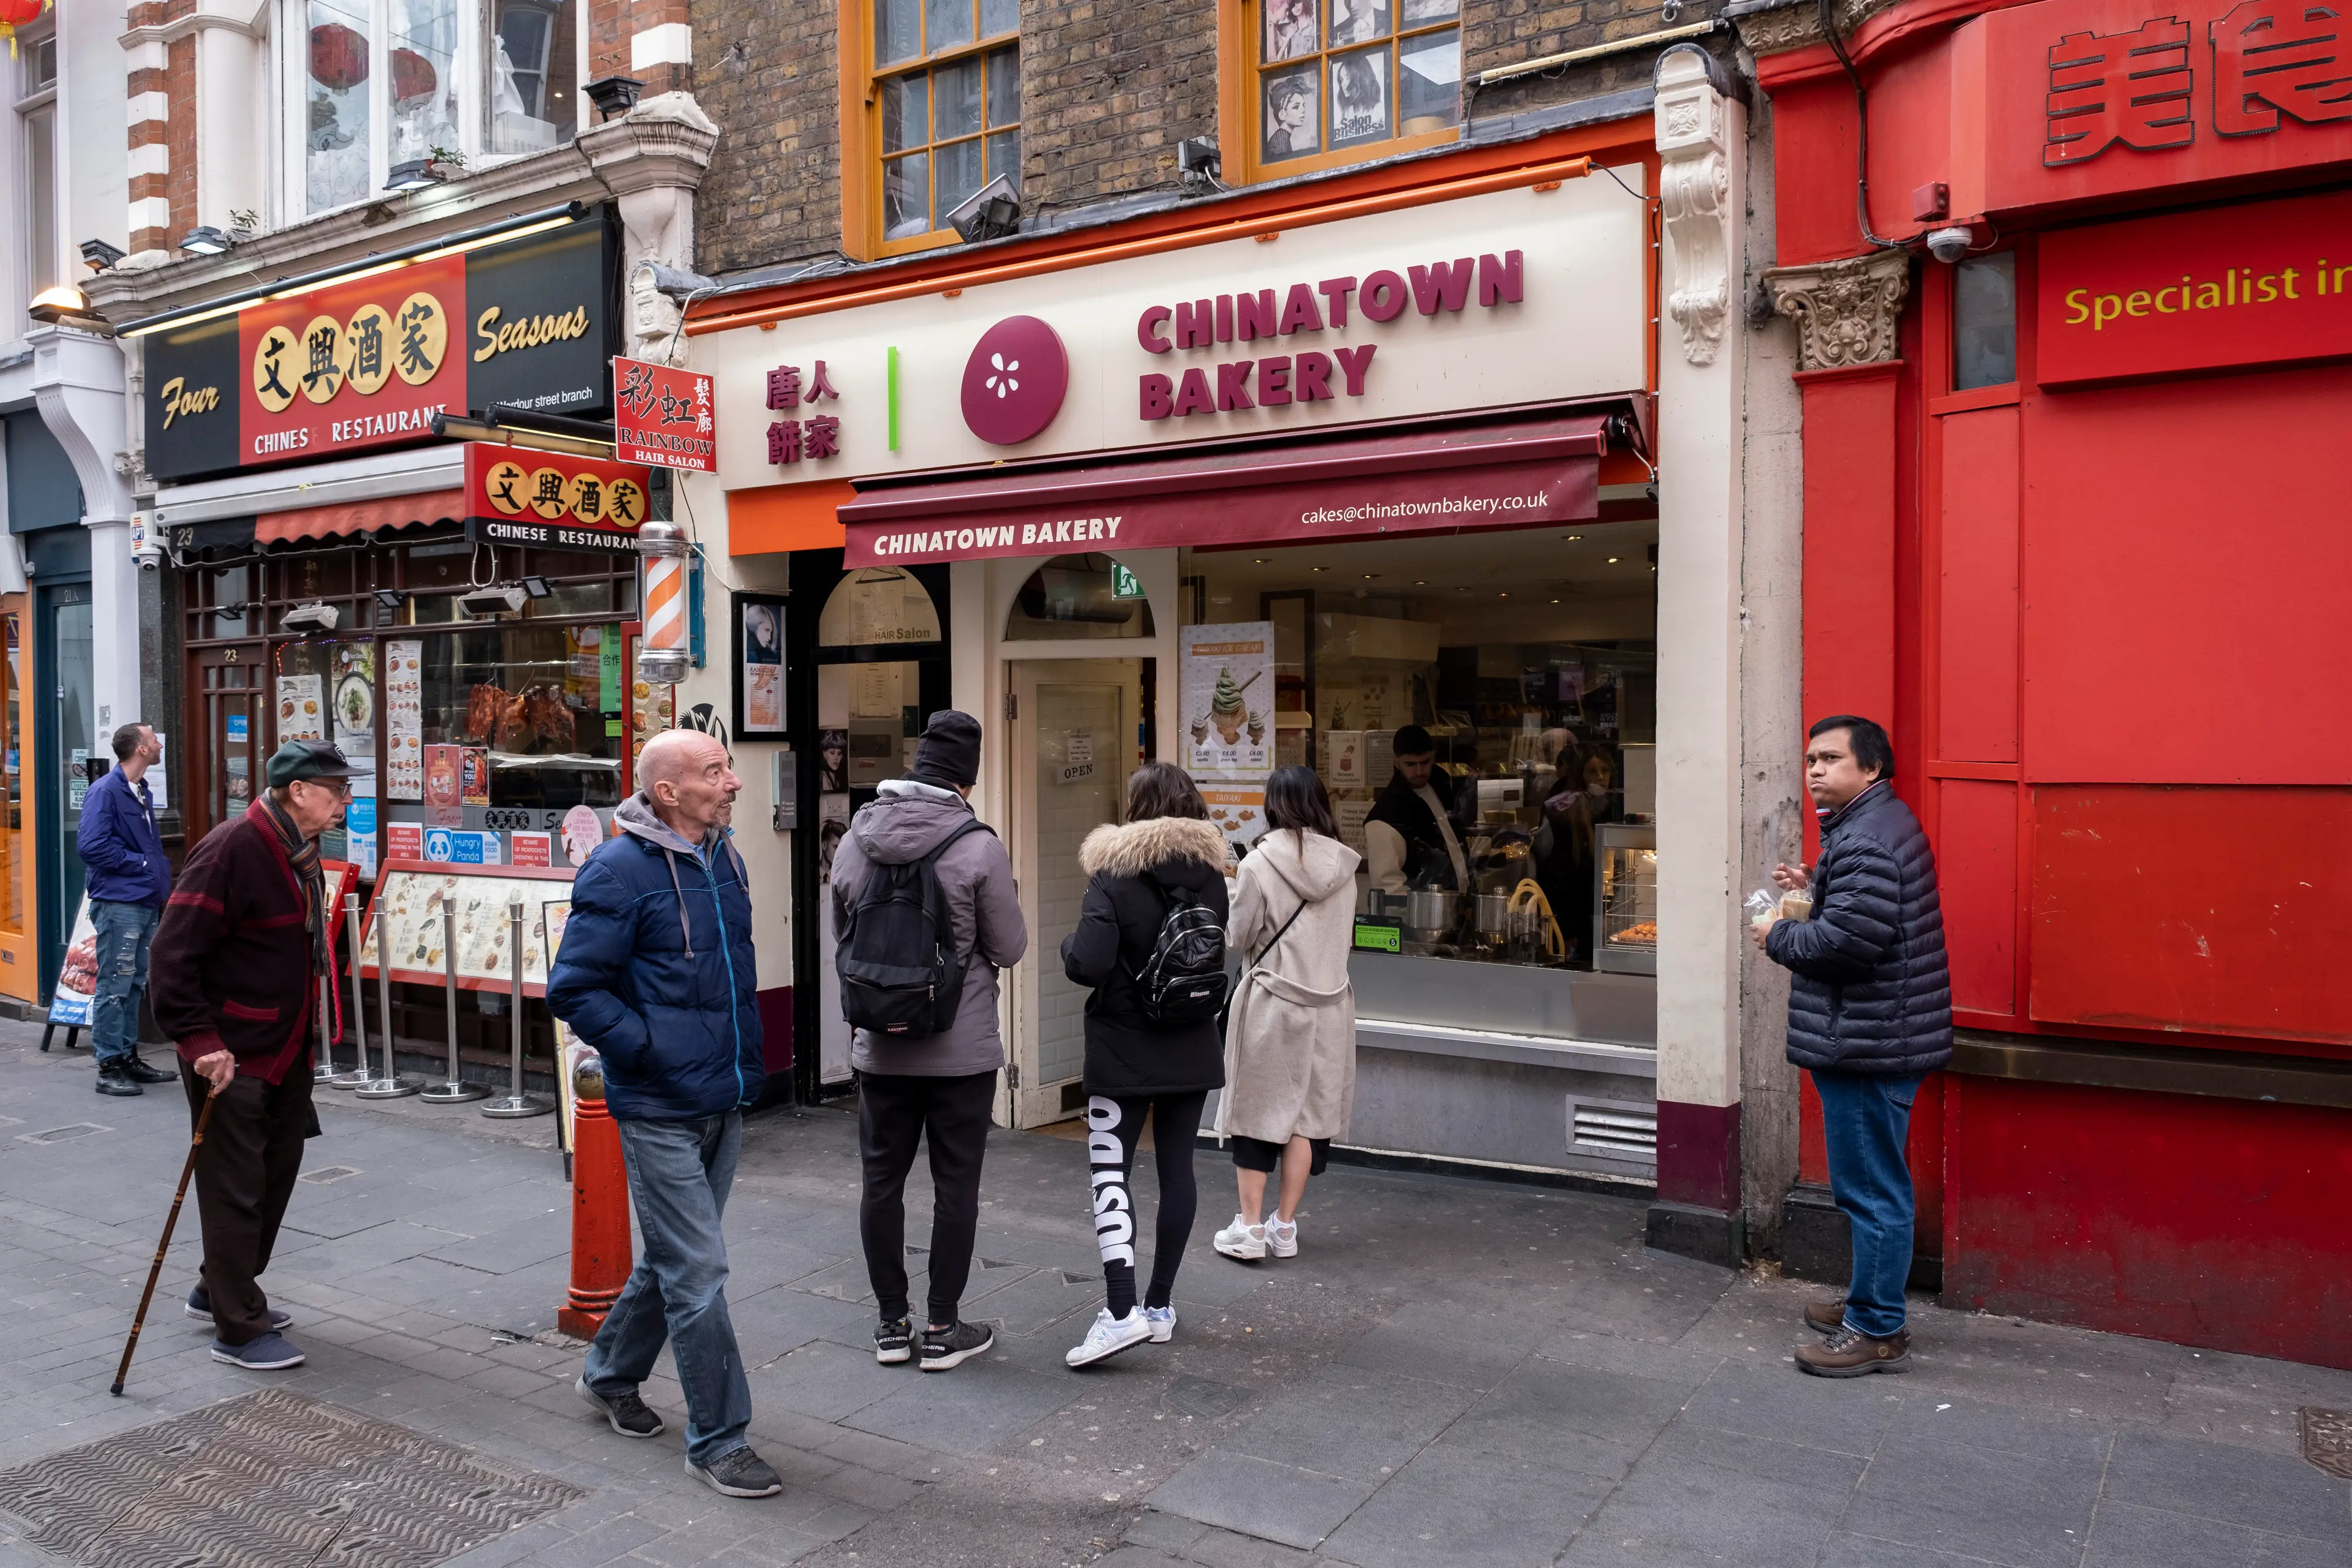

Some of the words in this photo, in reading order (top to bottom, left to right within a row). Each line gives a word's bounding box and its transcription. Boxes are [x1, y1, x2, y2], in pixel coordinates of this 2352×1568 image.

[1334, 123, 1384, 139] Business
[1341, 115, 1371, 130] Salon
[1137, 249, 1524, 355] CHINATOWN
[2065, 267, 2301, 330] Specialist
[473, 306, 590, 363] Seasons
[259, 302, 434, 399] 文興酒家
[496, 399, 533, 410] rdour
[535, 393, 560, 407] street
[562, 386, 592, 403] branch
[618, 364, 696, 426] 彩虹
[766, 360, 840, 410] 唐人
[1139, 344, 1378, 421] BAKERY
[162, 377, 220, 430] Four
[693, 377, 713, 436] 髮廊
[620, 427, 714, 457] RAINBOW
[766, 415, 840, 465] 餅家
[635, 450, 666, 466] HAIR
[668, 455, 705, 470] SALON
[492, 466, 638, 521] 文興酒家
[1302, 491, 1548, 524] cakes@chinatownbakery.co.uk
[177, 527, 194, 546] 23
[488, 524, 548, 541] CHINESE
[559, 530, 638, 550] RESTAURAN
[874, 525, 1015, 556] CHINATOWN
[1022, 516, 1122, 545] BAKERY
[875, 630, 895, 640] HAIR
[896, 627, 930, 639] Salon
[1236, 643, 1261, 652] CREAM
[225, 649, 238, 663] 23
[1064, 764, 1093, 778] OPEN
[454, 837, 481, 850] Hungry
[456, 851, 480, 861] Panda
